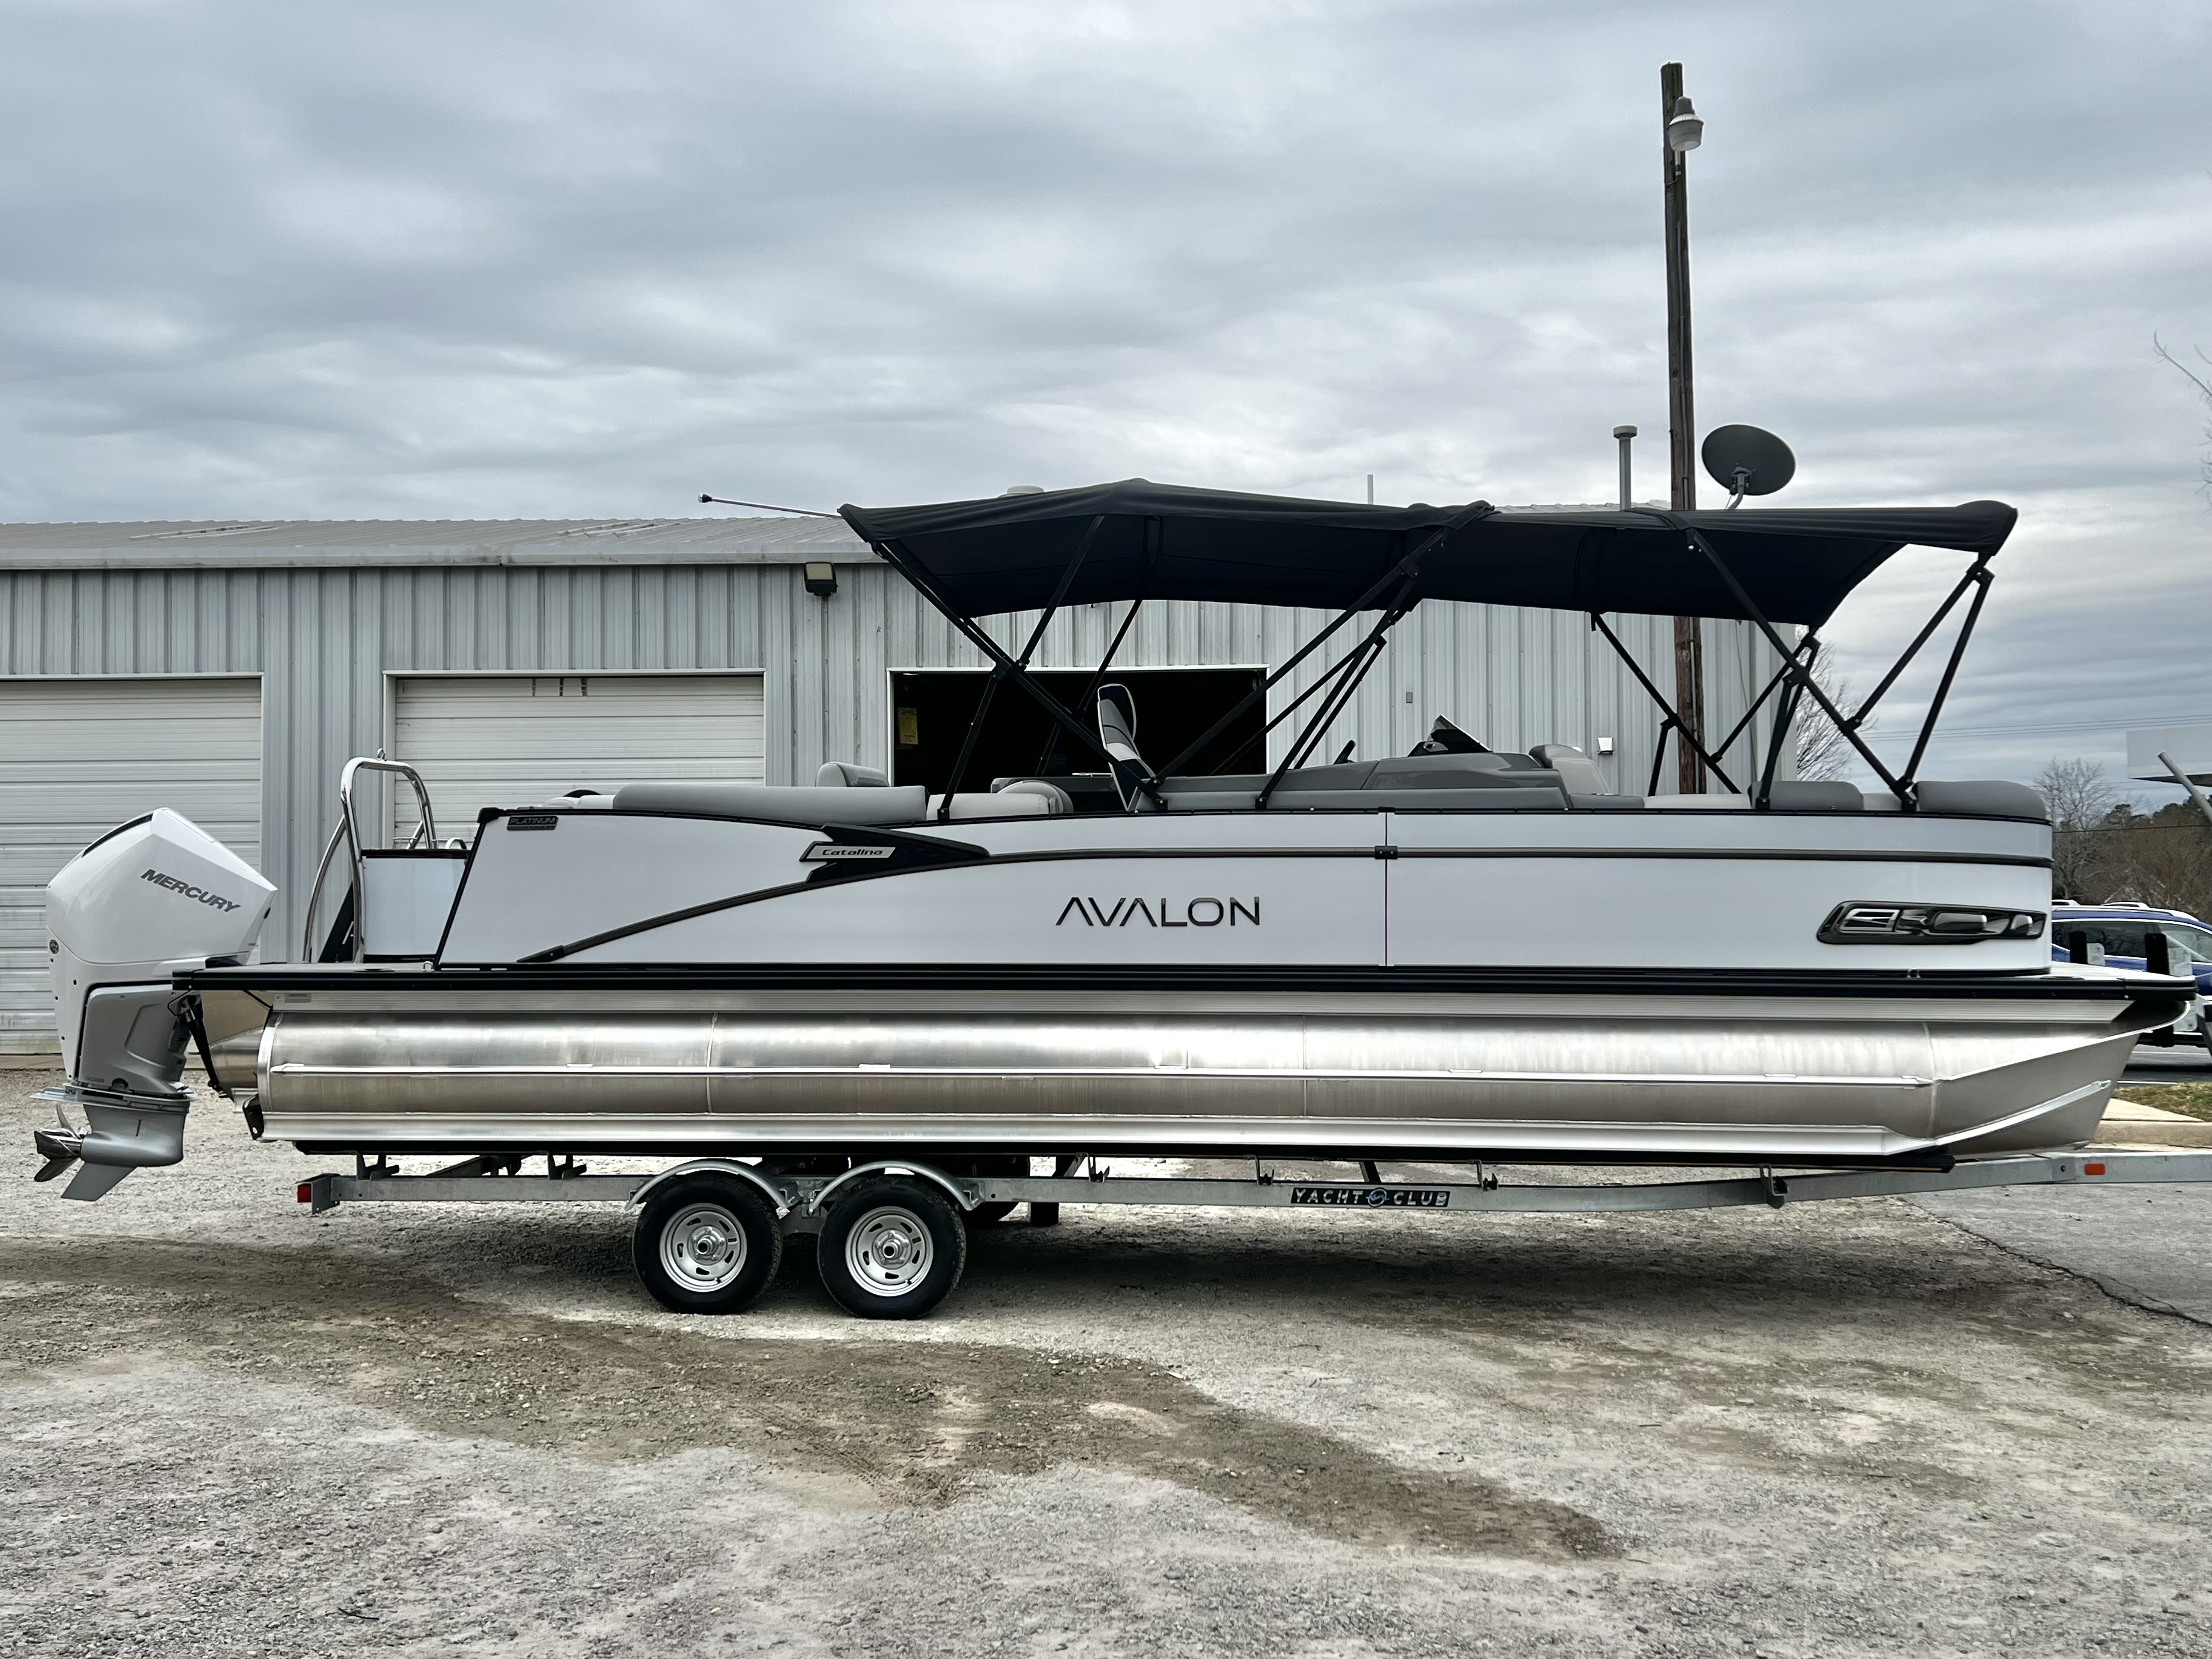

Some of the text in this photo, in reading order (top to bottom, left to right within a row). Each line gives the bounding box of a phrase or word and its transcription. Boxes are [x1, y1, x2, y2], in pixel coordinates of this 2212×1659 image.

[141, 869, 240, 912] MERCURY
[1055, 896, 1260, 927] AVALON
[1295, 1188, 1448, 1206] YACHT CLUB
